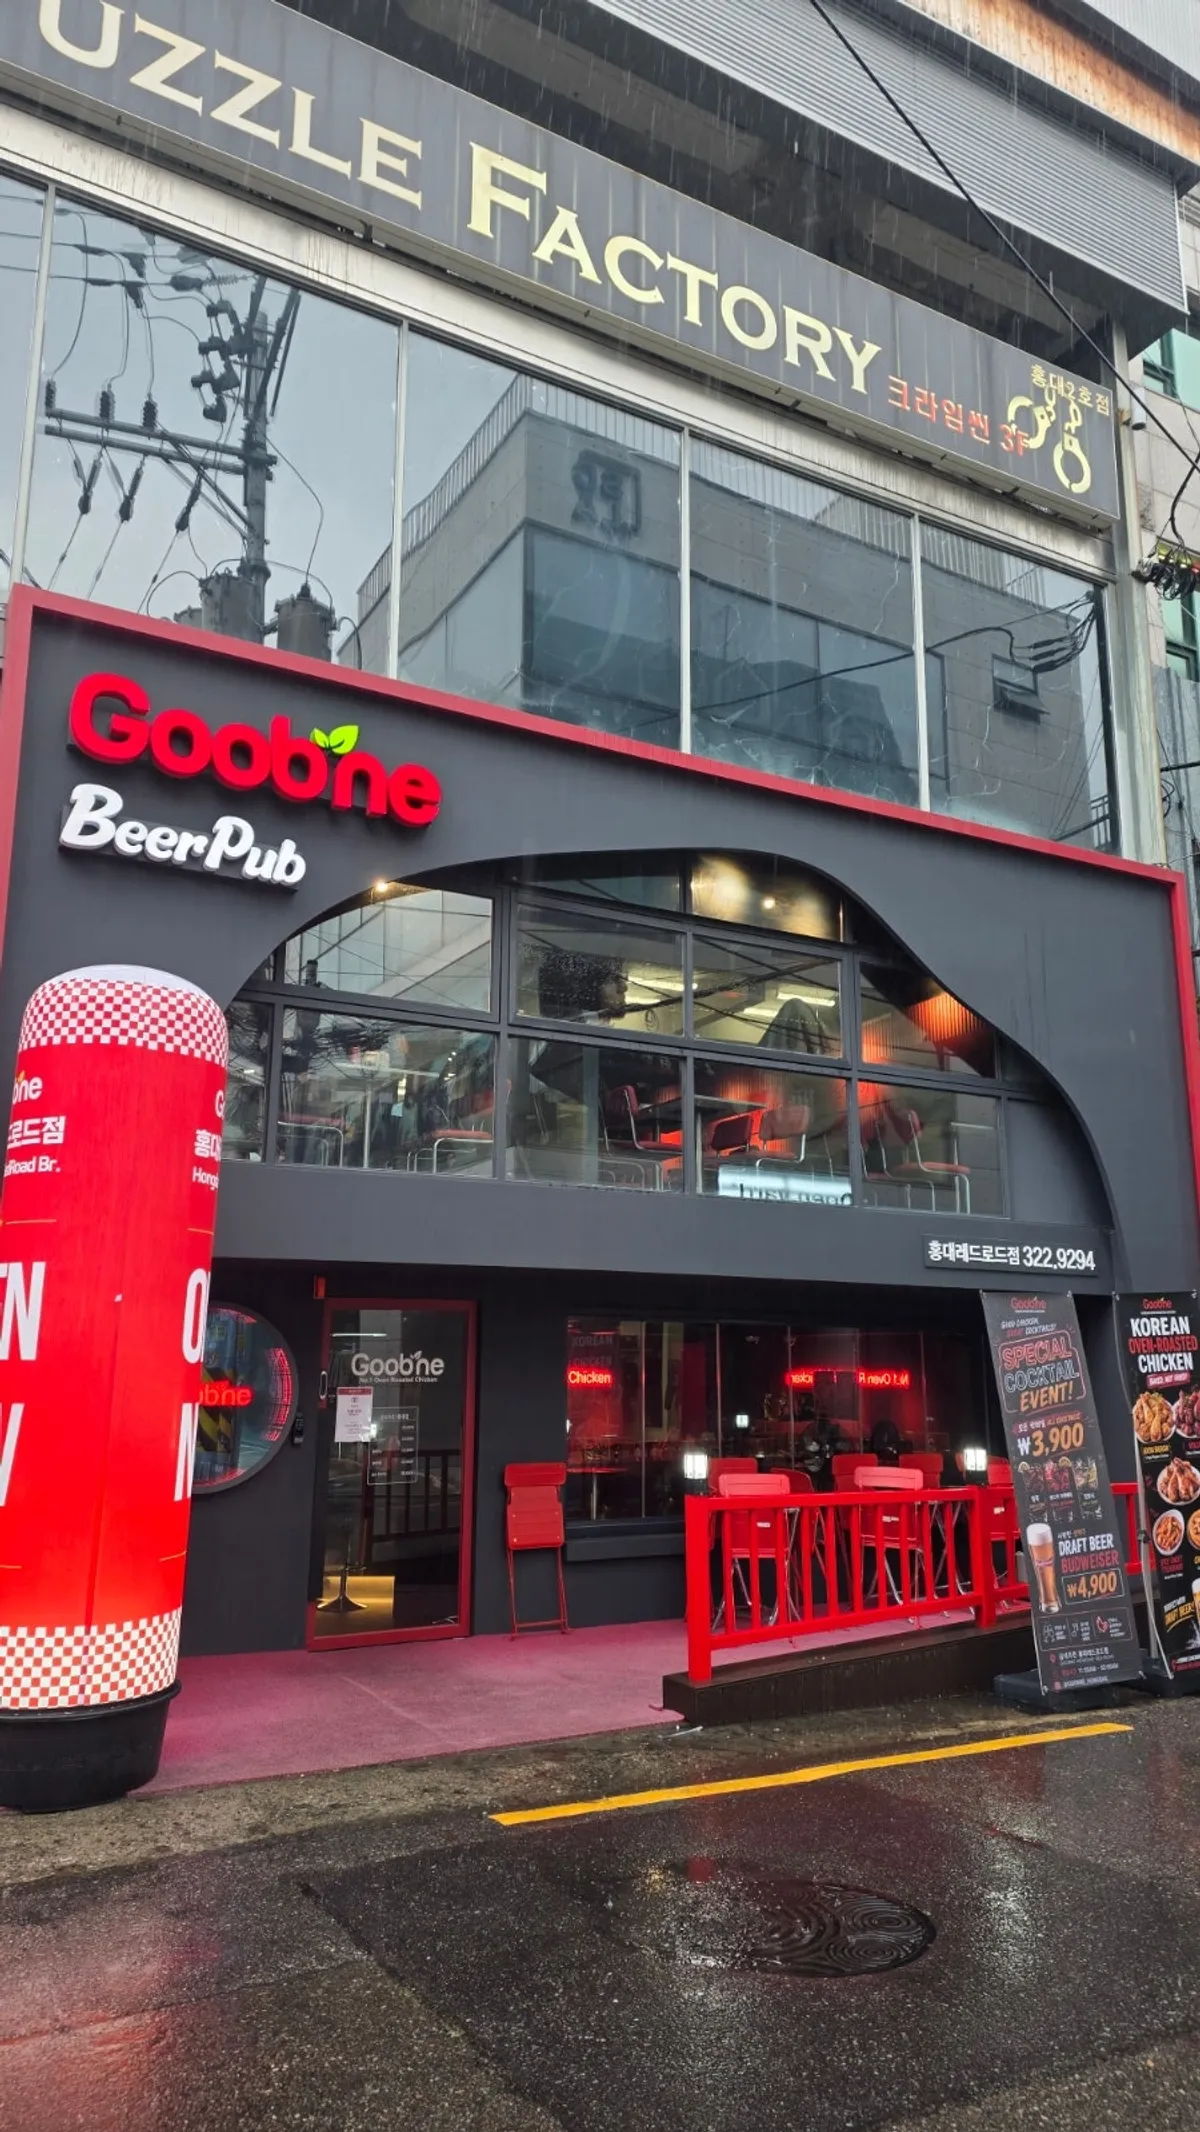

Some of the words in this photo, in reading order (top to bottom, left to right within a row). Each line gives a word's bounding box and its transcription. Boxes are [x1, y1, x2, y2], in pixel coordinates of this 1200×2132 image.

[467, 142, 881, 394] FACTORY
[1031, 364, 1110, 417] 홍대2호점
[888, 375, 990, 445] 크라임씬
[1000, 423, 1030, 456] 3F
[68, 672, 442, 828] Goobne
[38, 1154, 61, 1173] Br.
[928, 1240, 1020, 1265] 홍대레드로드점
[1023, 1246, 1096, 1271] 322.9294
[1130, 1316, 1190, 1337] KOREAN
[1002, 1336, 1073, 1371] SPECIAL
[1128, 1335, 1198, 1354] OVEN-ROASTED
[351, 1353, 445, 1376] Goobne
[1004, 1359, 1080, 1393] COCKTAIL
[1138, 1352, 1194, 1373] CHICKEN
[568, 1370, 611, 1384] Chicken
[1020, 1380, 1074, 1412] EVENT!
[1058, 1537, 1087, 1556] DRAFT
[1089, 1533, 1115, 1551] BEER
[1061, 1551, 1119, 1574] BUDWEISER
